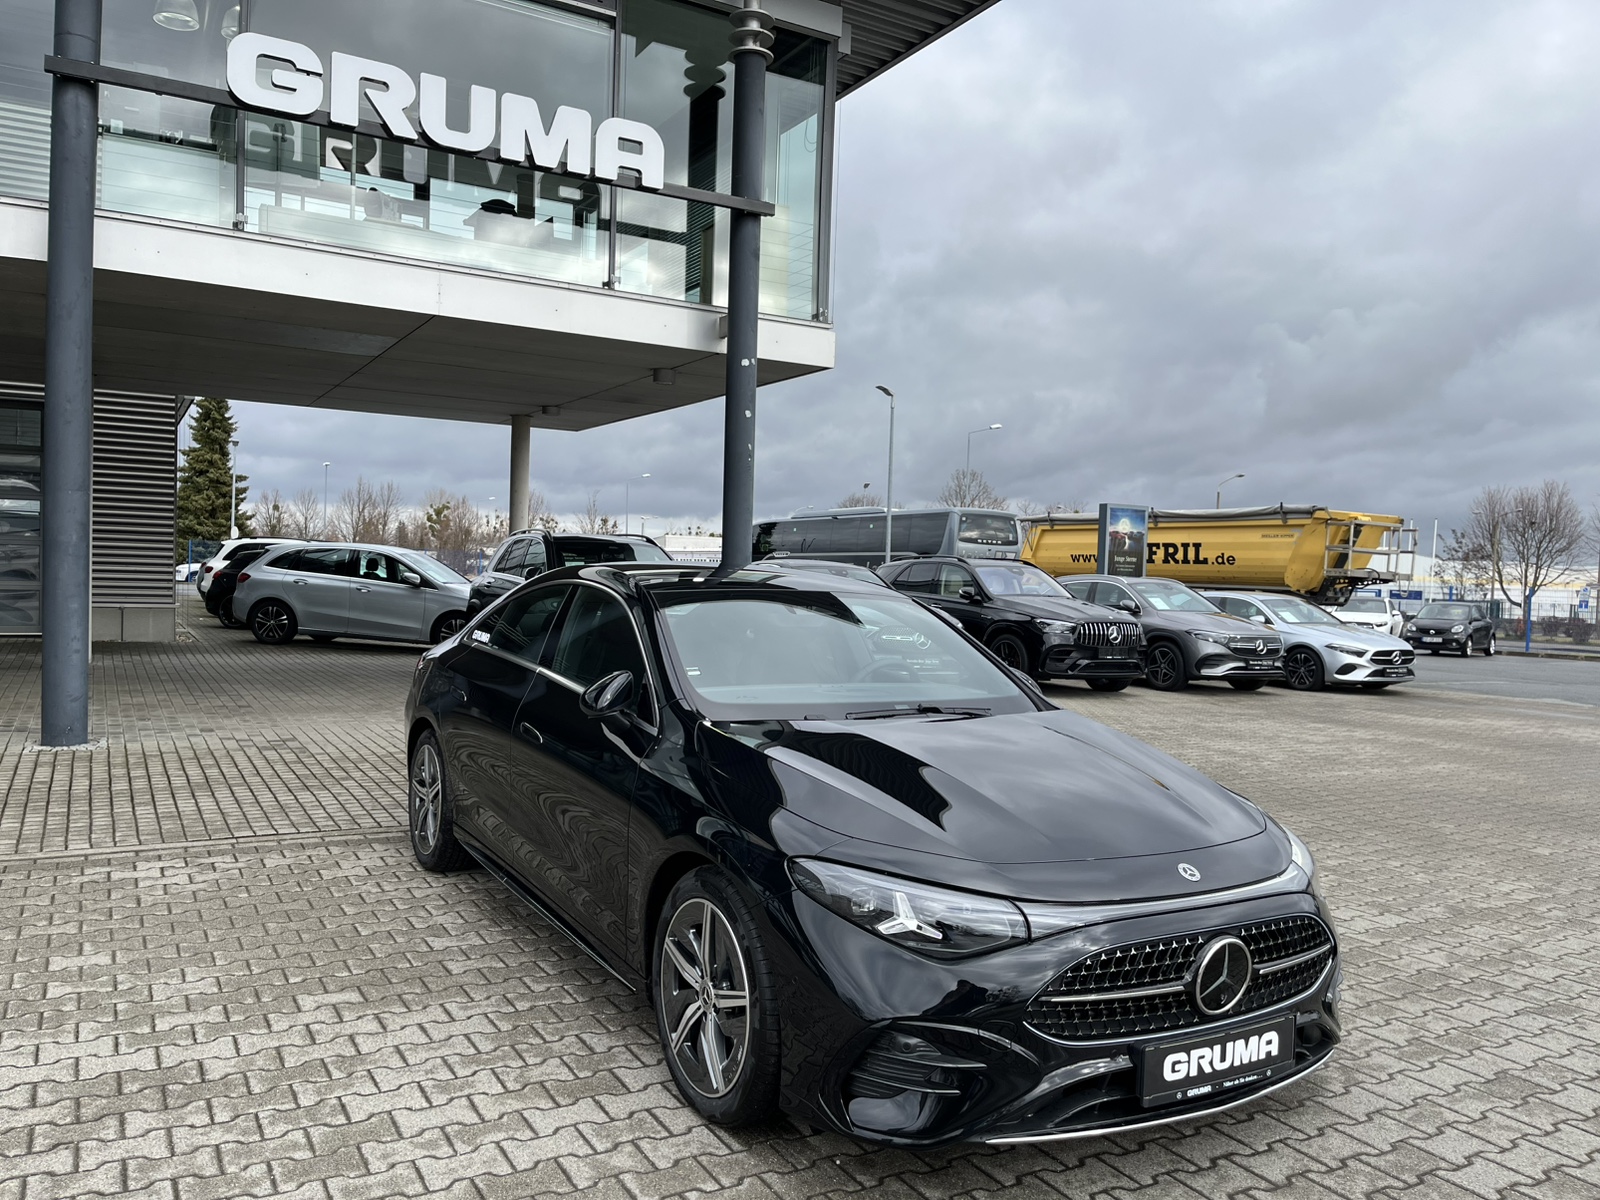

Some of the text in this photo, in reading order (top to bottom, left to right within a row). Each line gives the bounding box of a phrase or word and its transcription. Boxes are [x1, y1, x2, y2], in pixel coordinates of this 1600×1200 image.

[226, 32, 664, 190] GRUMA
[1163, 1030, 1279, 1082] GRUMA
[1187, 1085, 1212, 1097] GRUMA
